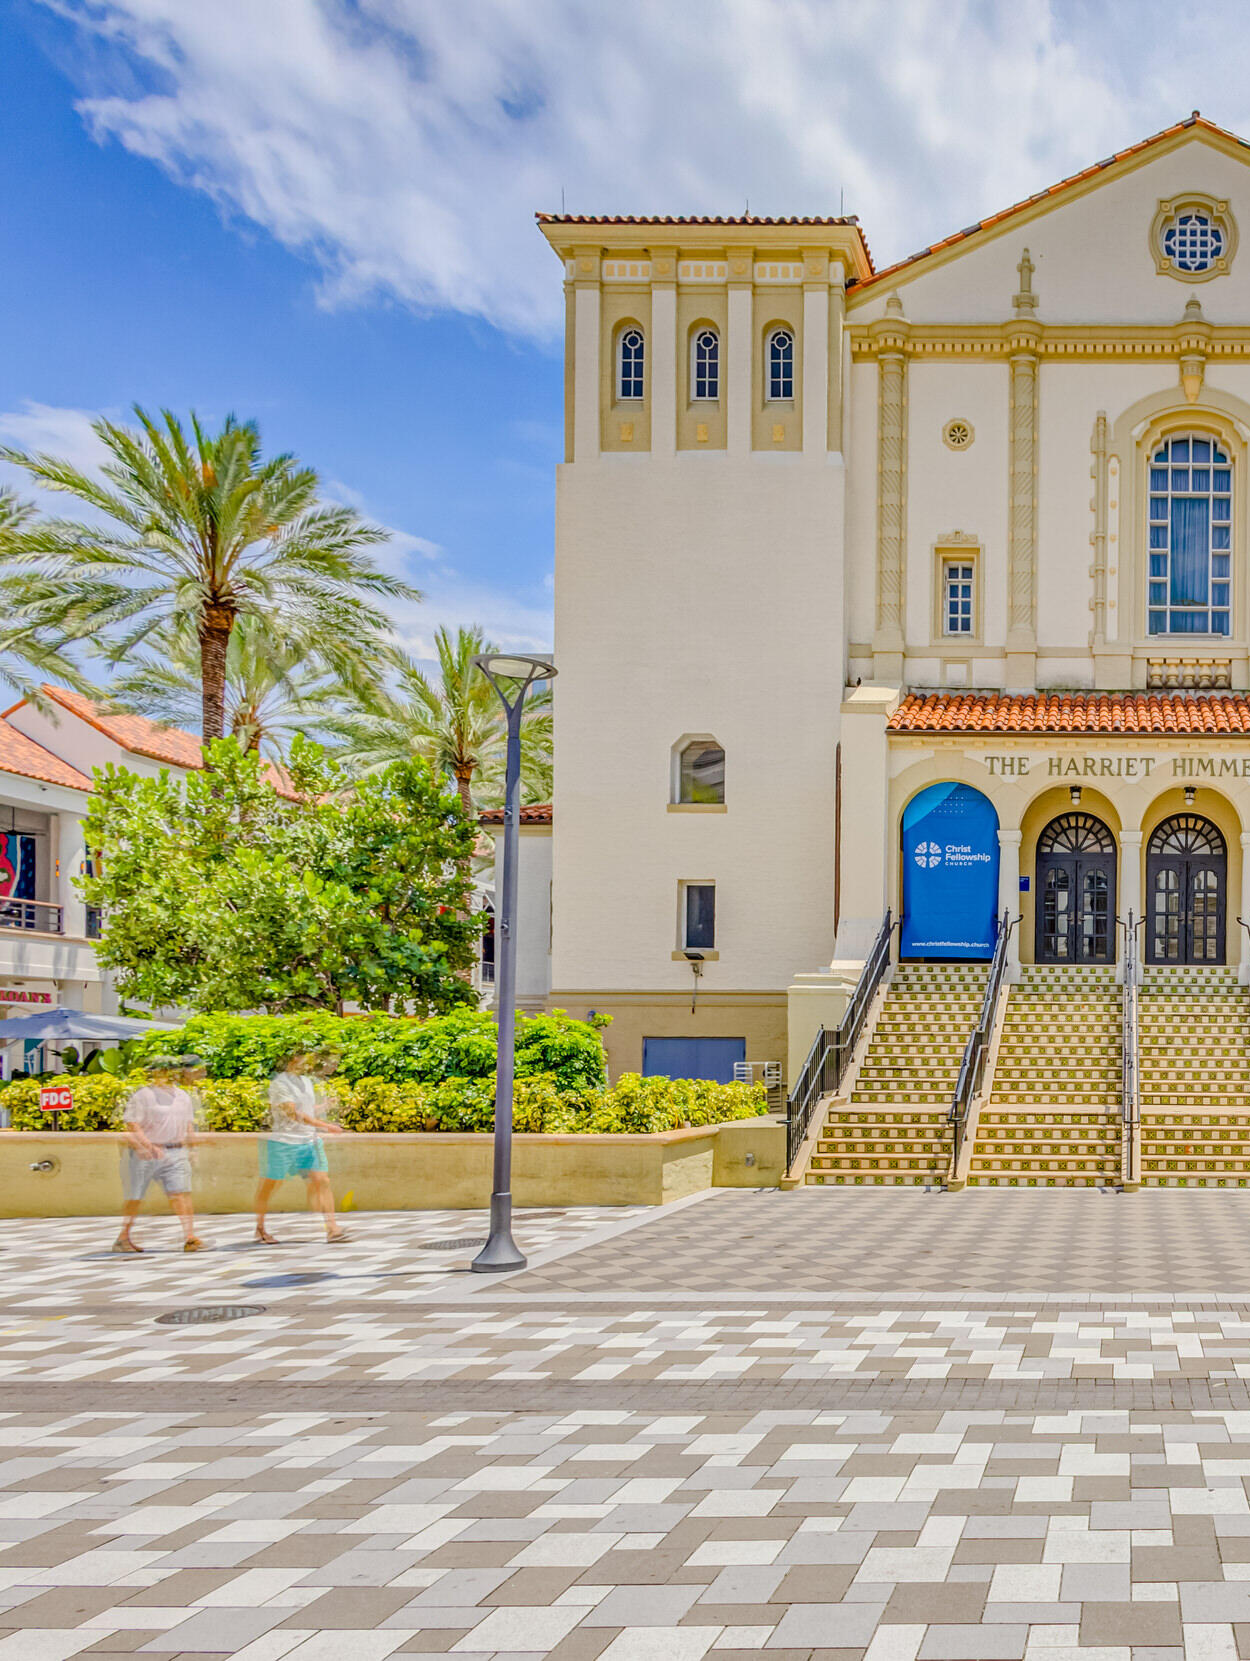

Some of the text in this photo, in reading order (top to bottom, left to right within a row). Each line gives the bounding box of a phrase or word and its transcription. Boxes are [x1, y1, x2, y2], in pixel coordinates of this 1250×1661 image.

[984, 756, 1030, 776] THE
[1047, 757, 1156, 777] HARRIET
[945, 845, 972, 853] Christ
[945, 853, 991, 863] Fellowship
[41, 1091, 70, 1106] FDC
